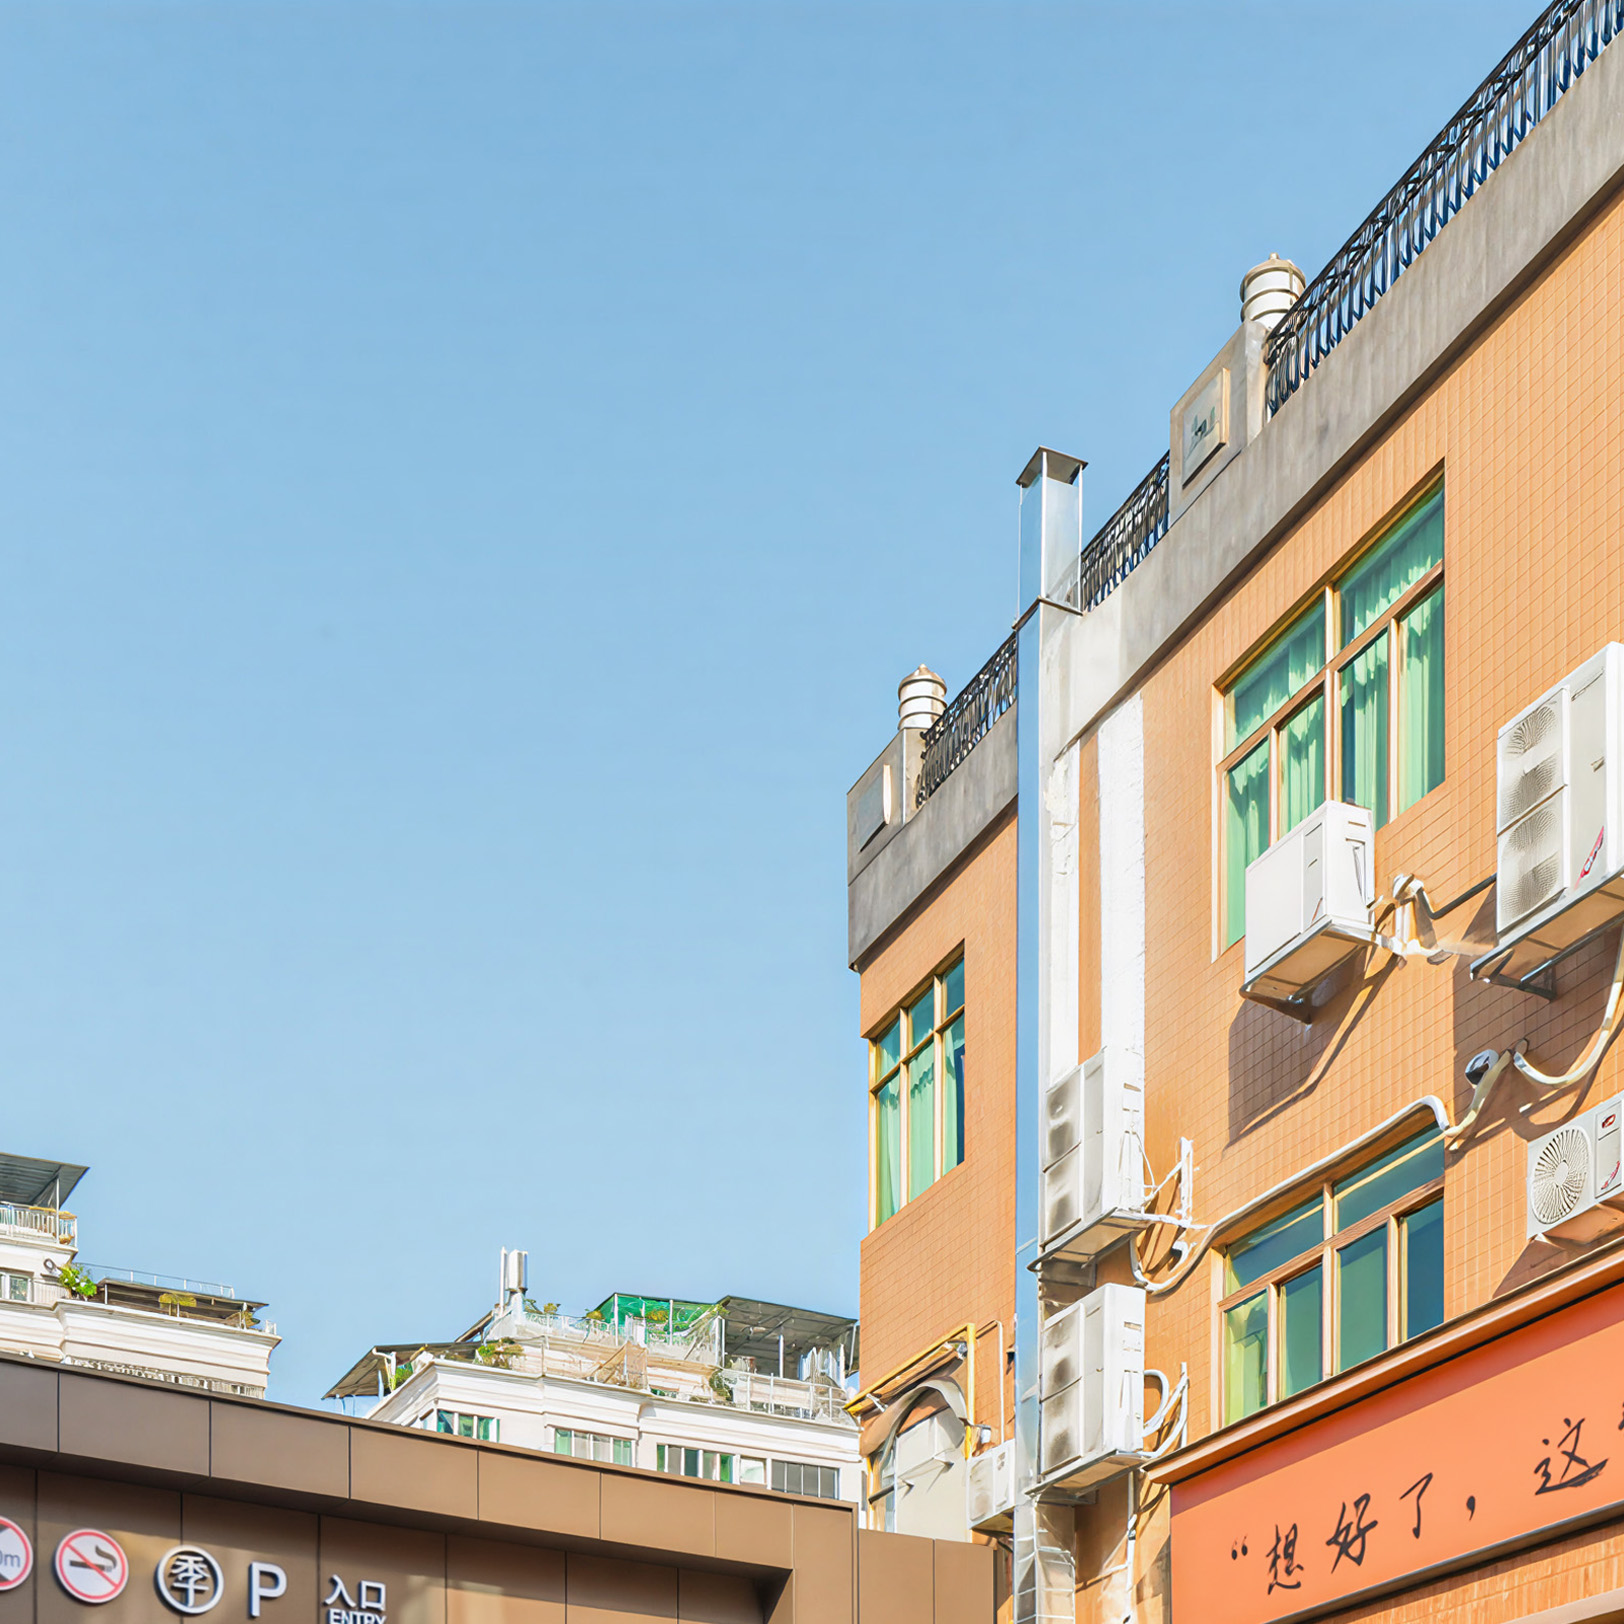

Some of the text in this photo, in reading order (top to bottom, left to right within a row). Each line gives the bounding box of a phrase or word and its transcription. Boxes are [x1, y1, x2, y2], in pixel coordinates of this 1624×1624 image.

[170, 1554, 210, 1608] 季
[249, 1561, 287, 1618] P
[324, 1574, 386, 1611] 入口
